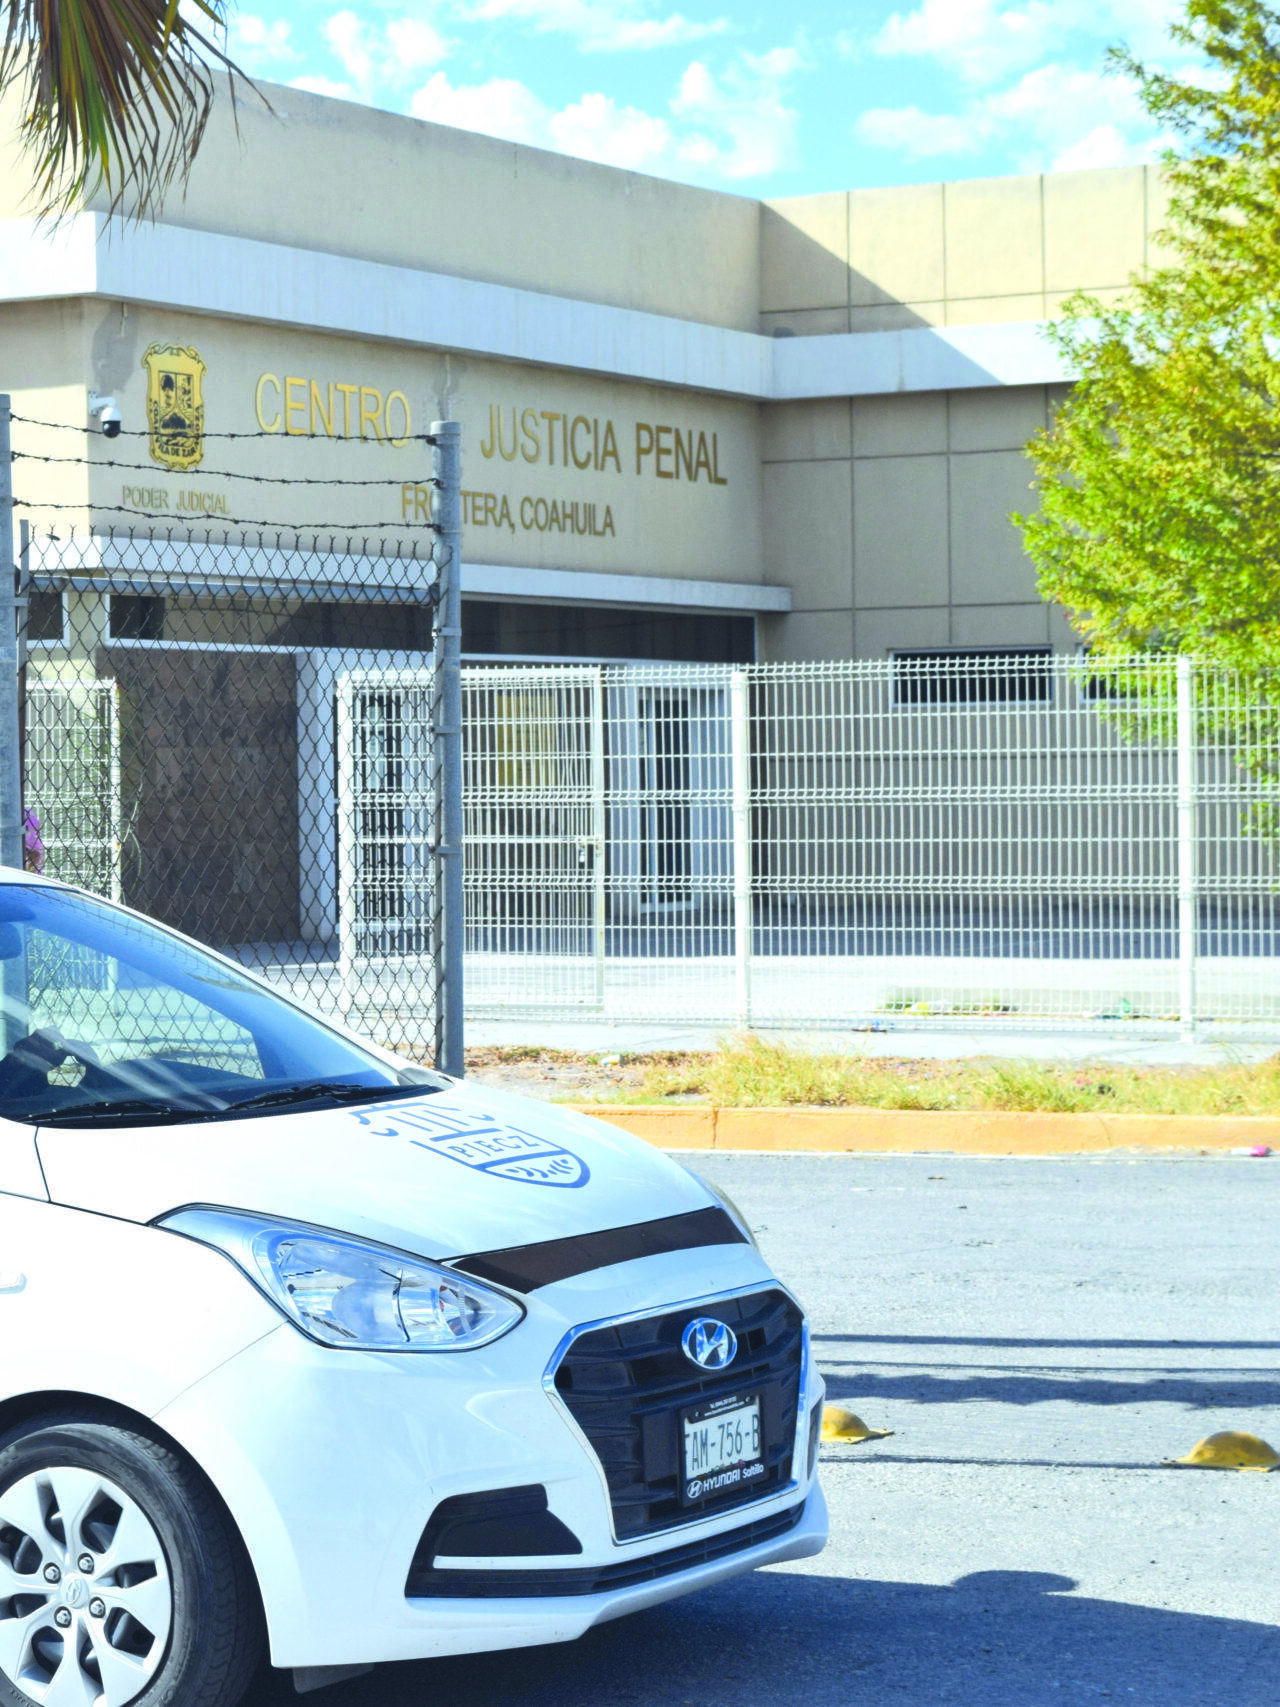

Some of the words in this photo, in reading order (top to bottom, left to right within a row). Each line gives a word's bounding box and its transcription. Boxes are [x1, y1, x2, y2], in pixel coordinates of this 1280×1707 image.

[255, 373, 411, 448] CENTRO
[480, 403, 622, 474] JUSTICIA
[635, 422, 728, 486] PENAL
[122, 485, 169, 509] PODER
[176, 490, 231, 515] JUDICIAL
[401, 485, 516, 534] FRTERA,
[520, 496, 616, 537] COAHUILA
[703, 1469, 741, 1492] HYUNDAI
